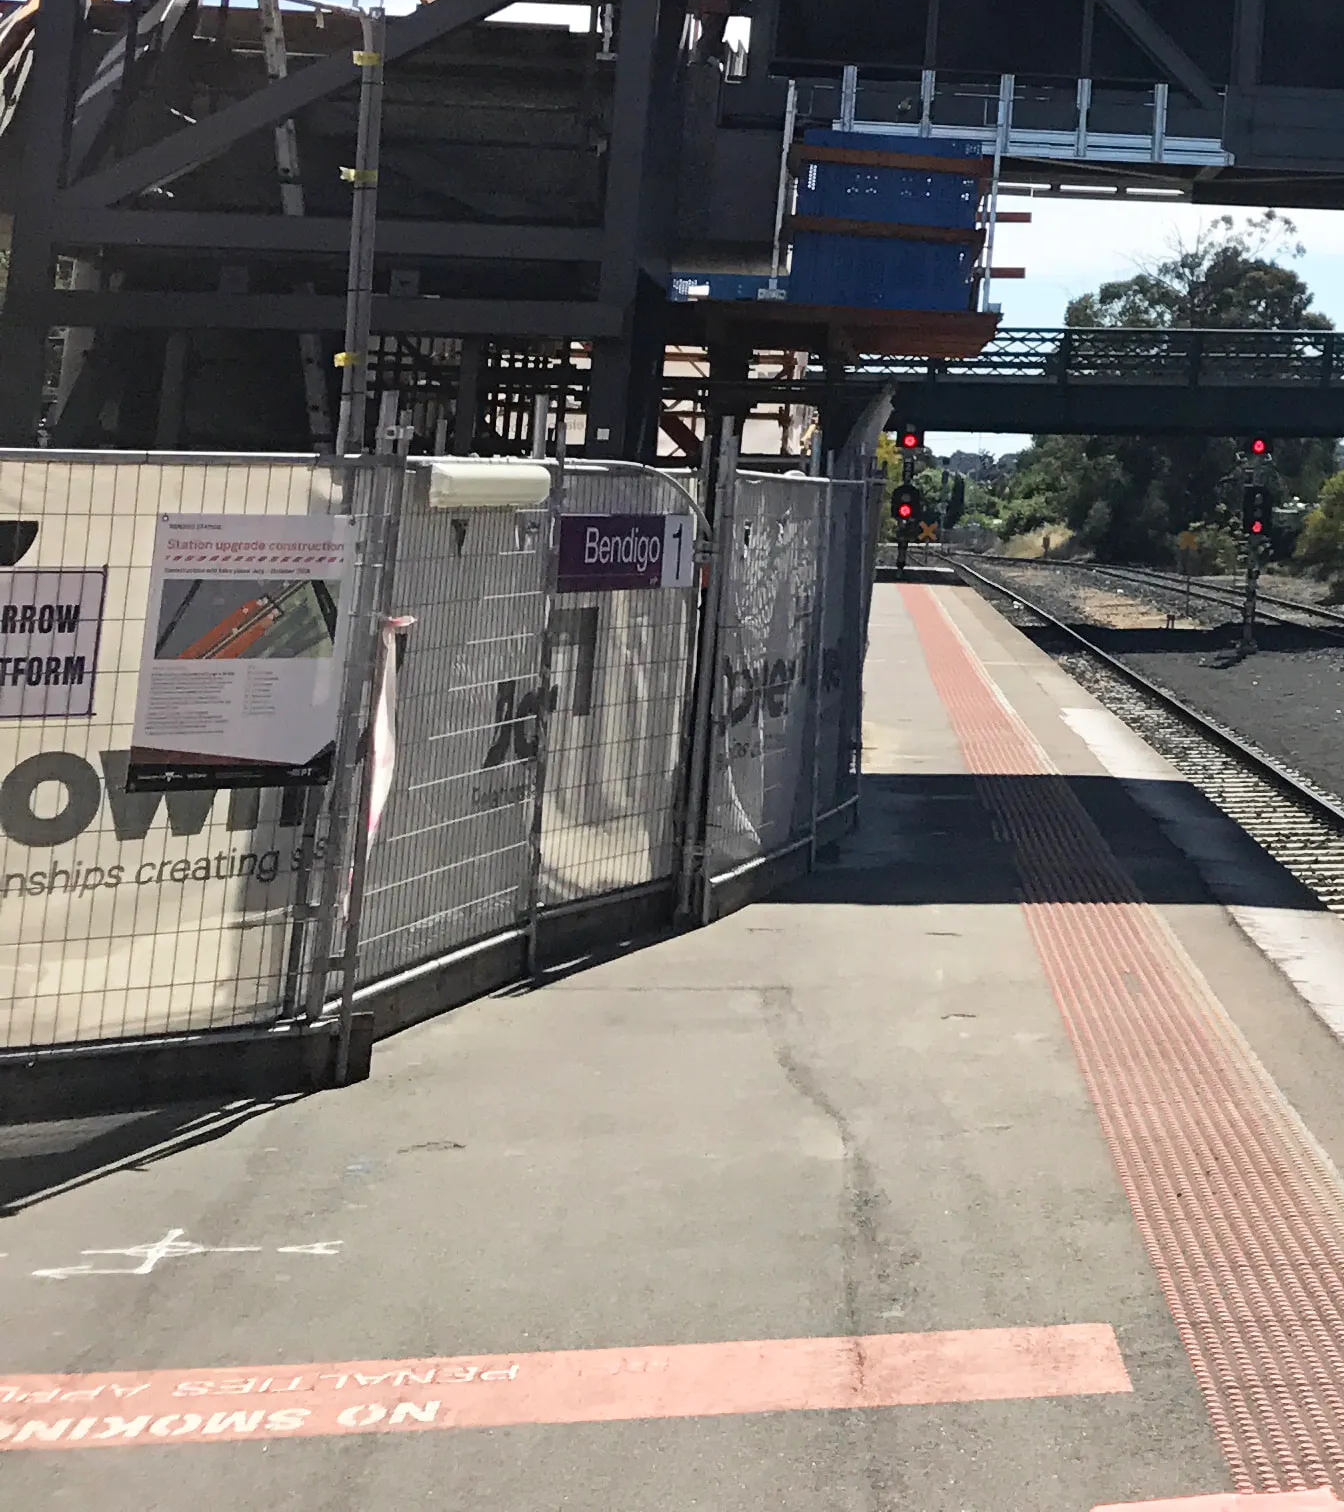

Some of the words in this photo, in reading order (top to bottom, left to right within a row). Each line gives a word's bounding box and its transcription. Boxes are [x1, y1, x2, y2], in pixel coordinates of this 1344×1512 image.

[167, 538, 213, 550] Station
[215, 540, 266, 552] upgrade
[268, 541, 344, 552] construction
[584, 526, 661, 572] Bendigo
[673, 522, 683, 580] 1
[135, 848, 280, 882] creating
[336, 1400, 441, 1427] NO
